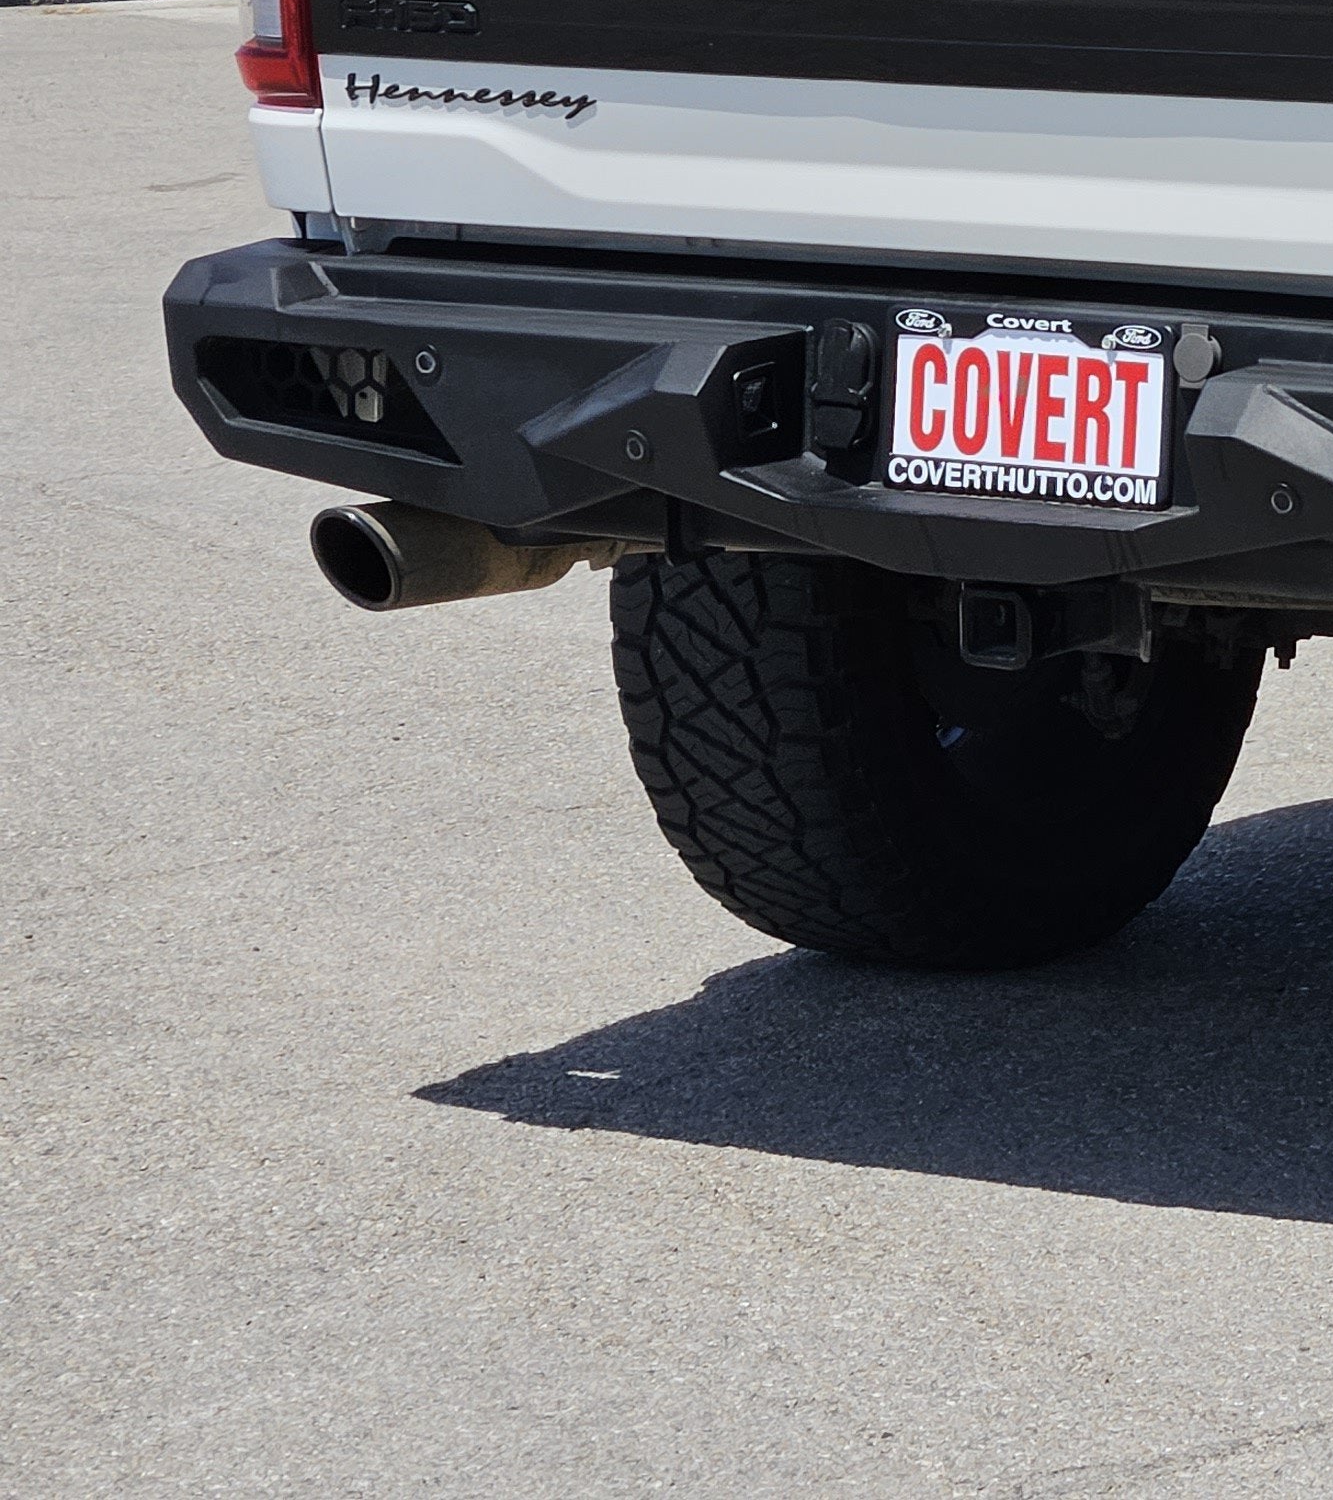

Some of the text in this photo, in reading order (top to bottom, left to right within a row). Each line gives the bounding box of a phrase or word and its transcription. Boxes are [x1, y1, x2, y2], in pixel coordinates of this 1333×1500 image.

[345, 72, 597, 120] Hennessey
[986, 312, 1072, 333] Covert
[908, 343, 1150, 469] COVERT
[887, 457, 1158, 506] COVERTHUTTO.COM
